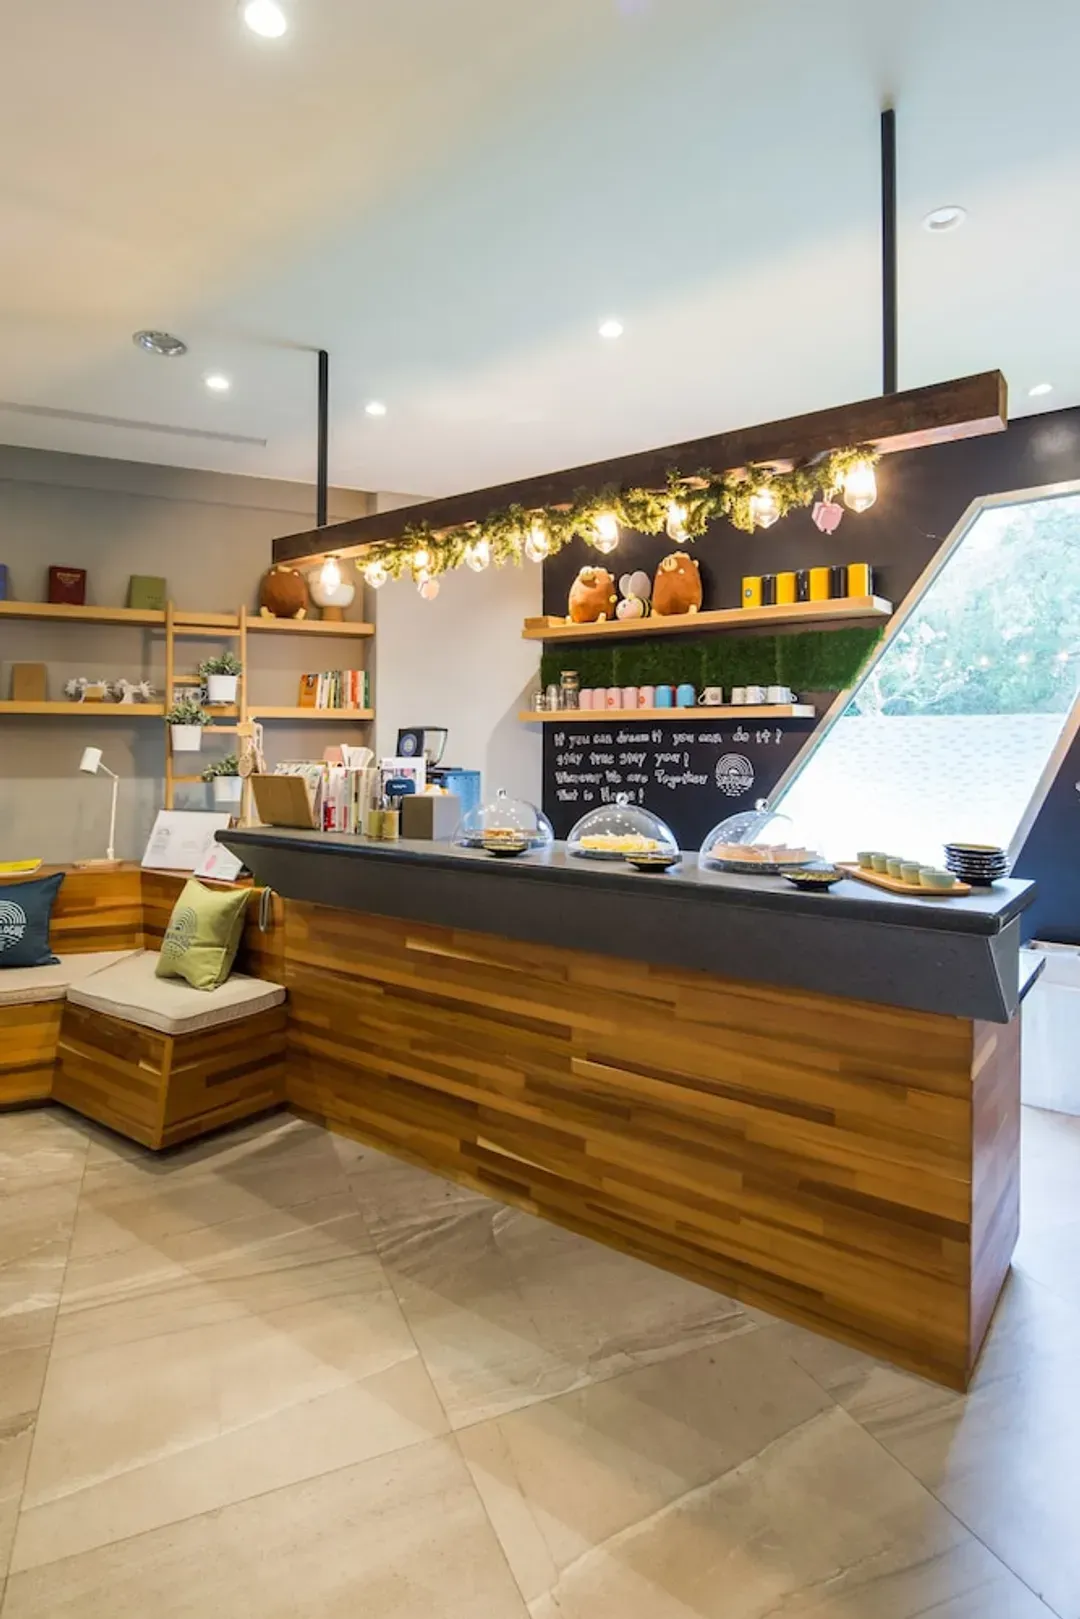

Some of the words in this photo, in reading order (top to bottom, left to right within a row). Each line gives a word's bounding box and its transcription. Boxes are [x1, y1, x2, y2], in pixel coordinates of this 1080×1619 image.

[569, 735, 590, 749] you
[593, 733, 613, 744] can
[672, 734, 694, 746] you
[698, 733, 722, 743] can
[732, 726, 750, 742] do
